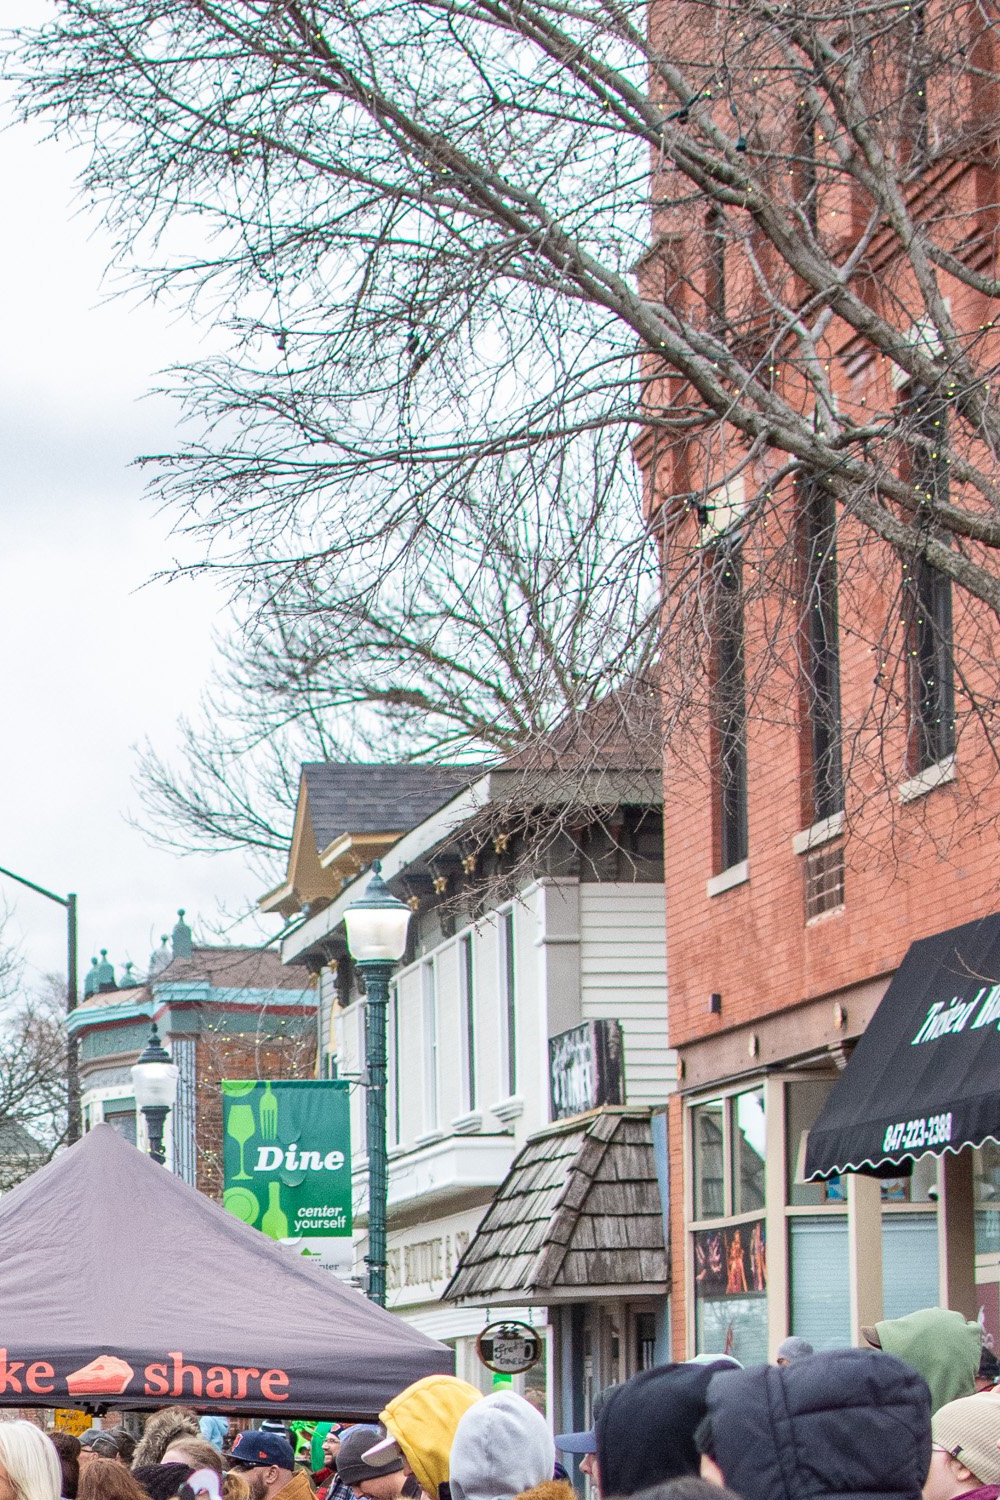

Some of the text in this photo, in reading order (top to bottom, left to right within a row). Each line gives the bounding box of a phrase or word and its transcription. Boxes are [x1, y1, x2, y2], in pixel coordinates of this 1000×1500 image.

[254, 1143, 345, 1171] Dine
[297, 1205, 343, 1217] center
[294, 1215, 347, 1231] yourself
[144, 1352, 289, 1401] share
